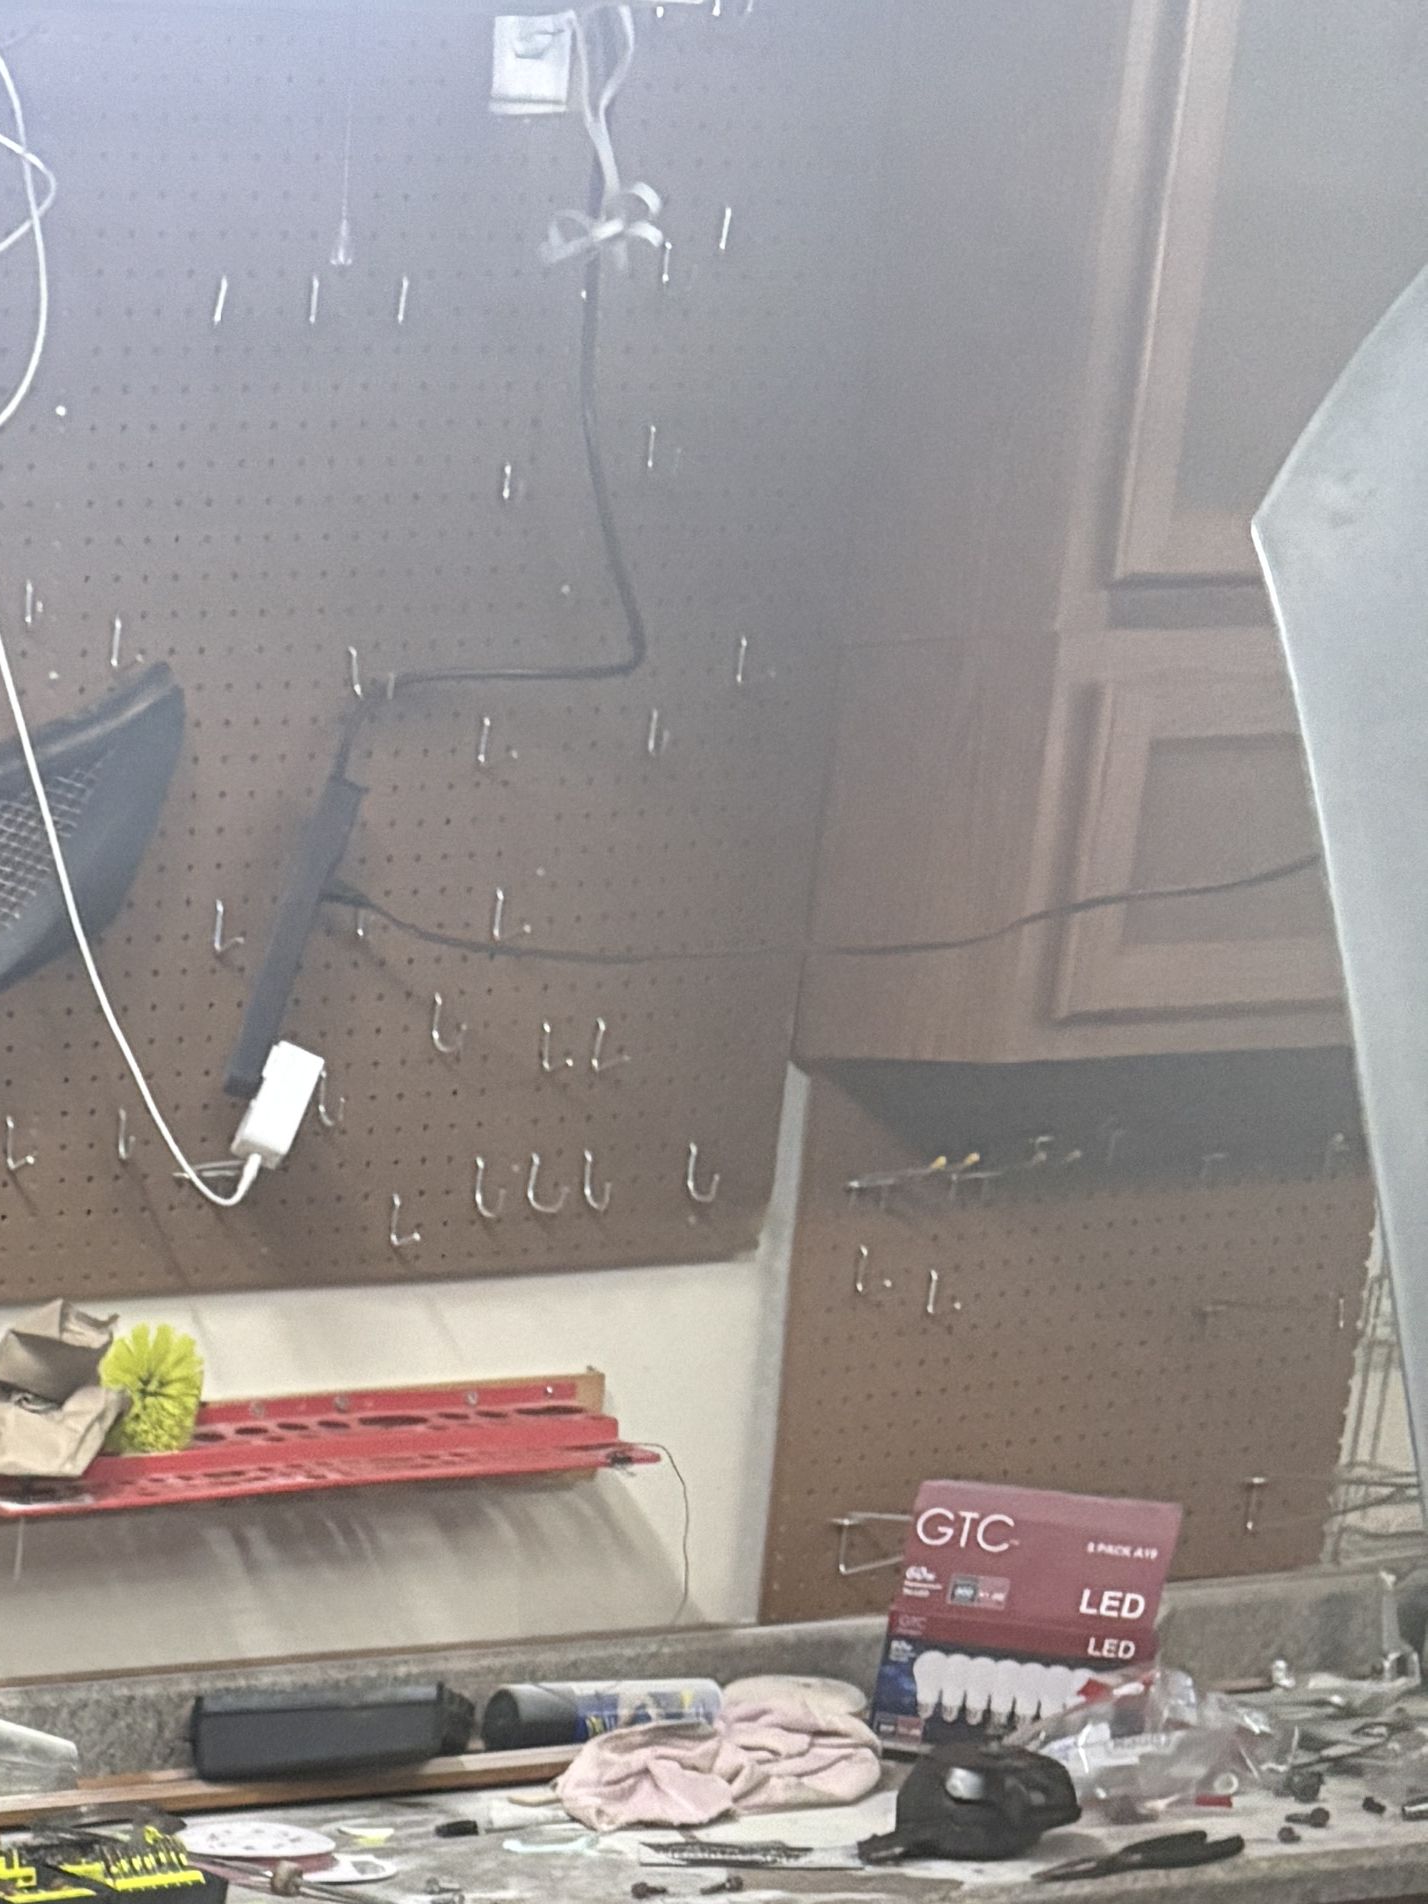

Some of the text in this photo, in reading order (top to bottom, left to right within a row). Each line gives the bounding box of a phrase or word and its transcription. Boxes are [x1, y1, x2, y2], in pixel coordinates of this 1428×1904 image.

[916, 1507, 1015, 1552] GTC
[1079, 1588, 1145, 1619] LED
[1087, 1637, 1136, 1659] LED
